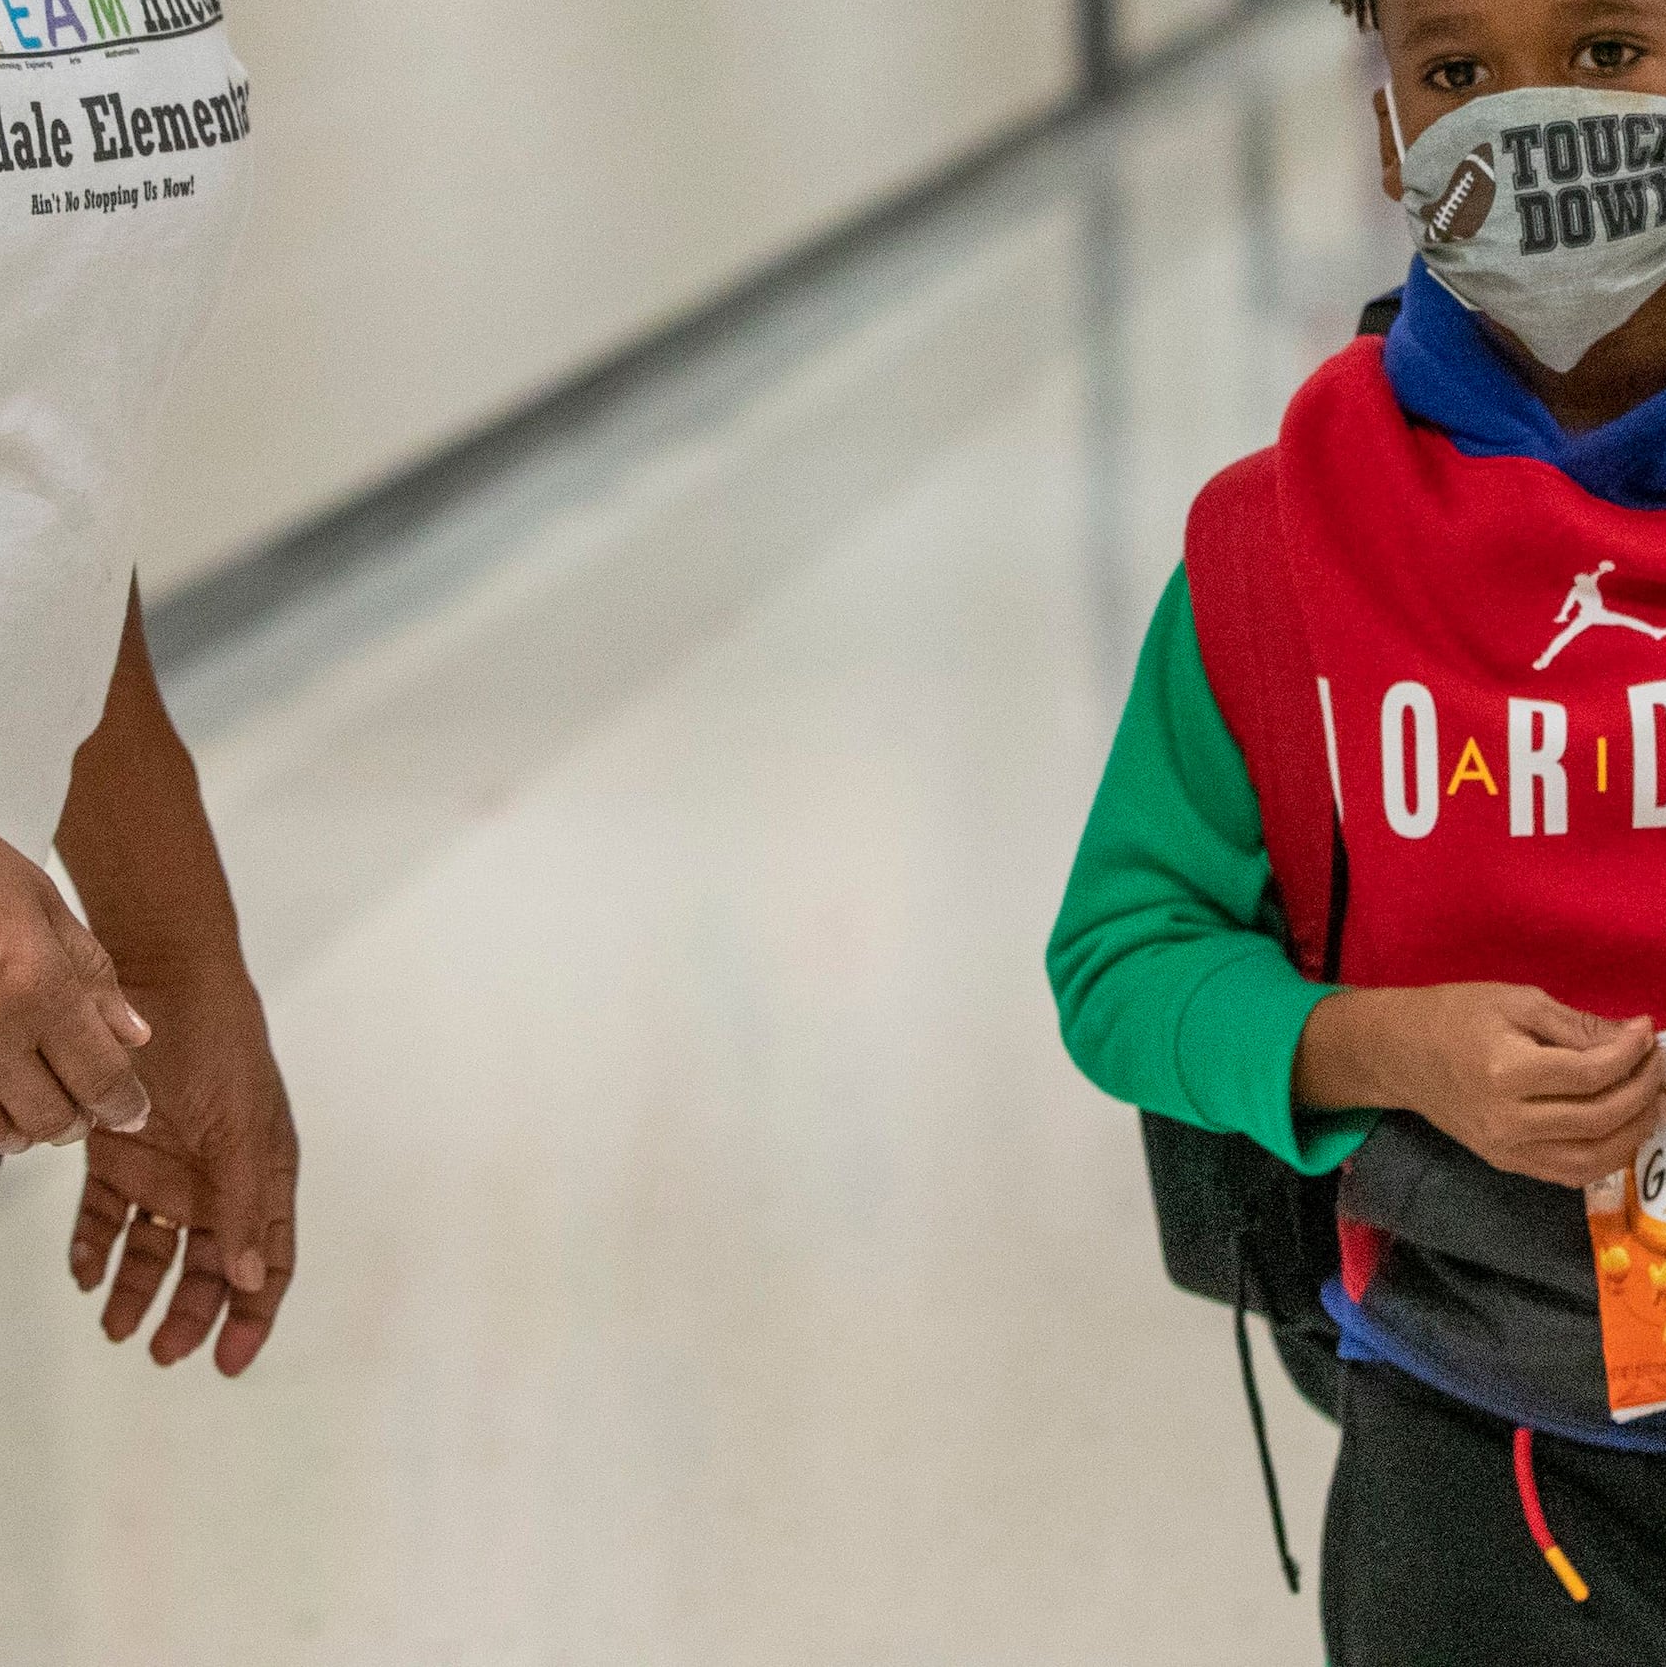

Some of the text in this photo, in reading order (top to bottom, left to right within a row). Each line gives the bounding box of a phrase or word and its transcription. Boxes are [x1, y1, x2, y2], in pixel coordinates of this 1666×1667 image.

[79, 75, 250, 163] Elementa
[31, 174, 195, 216] Ain't No Stopping Us Now!
